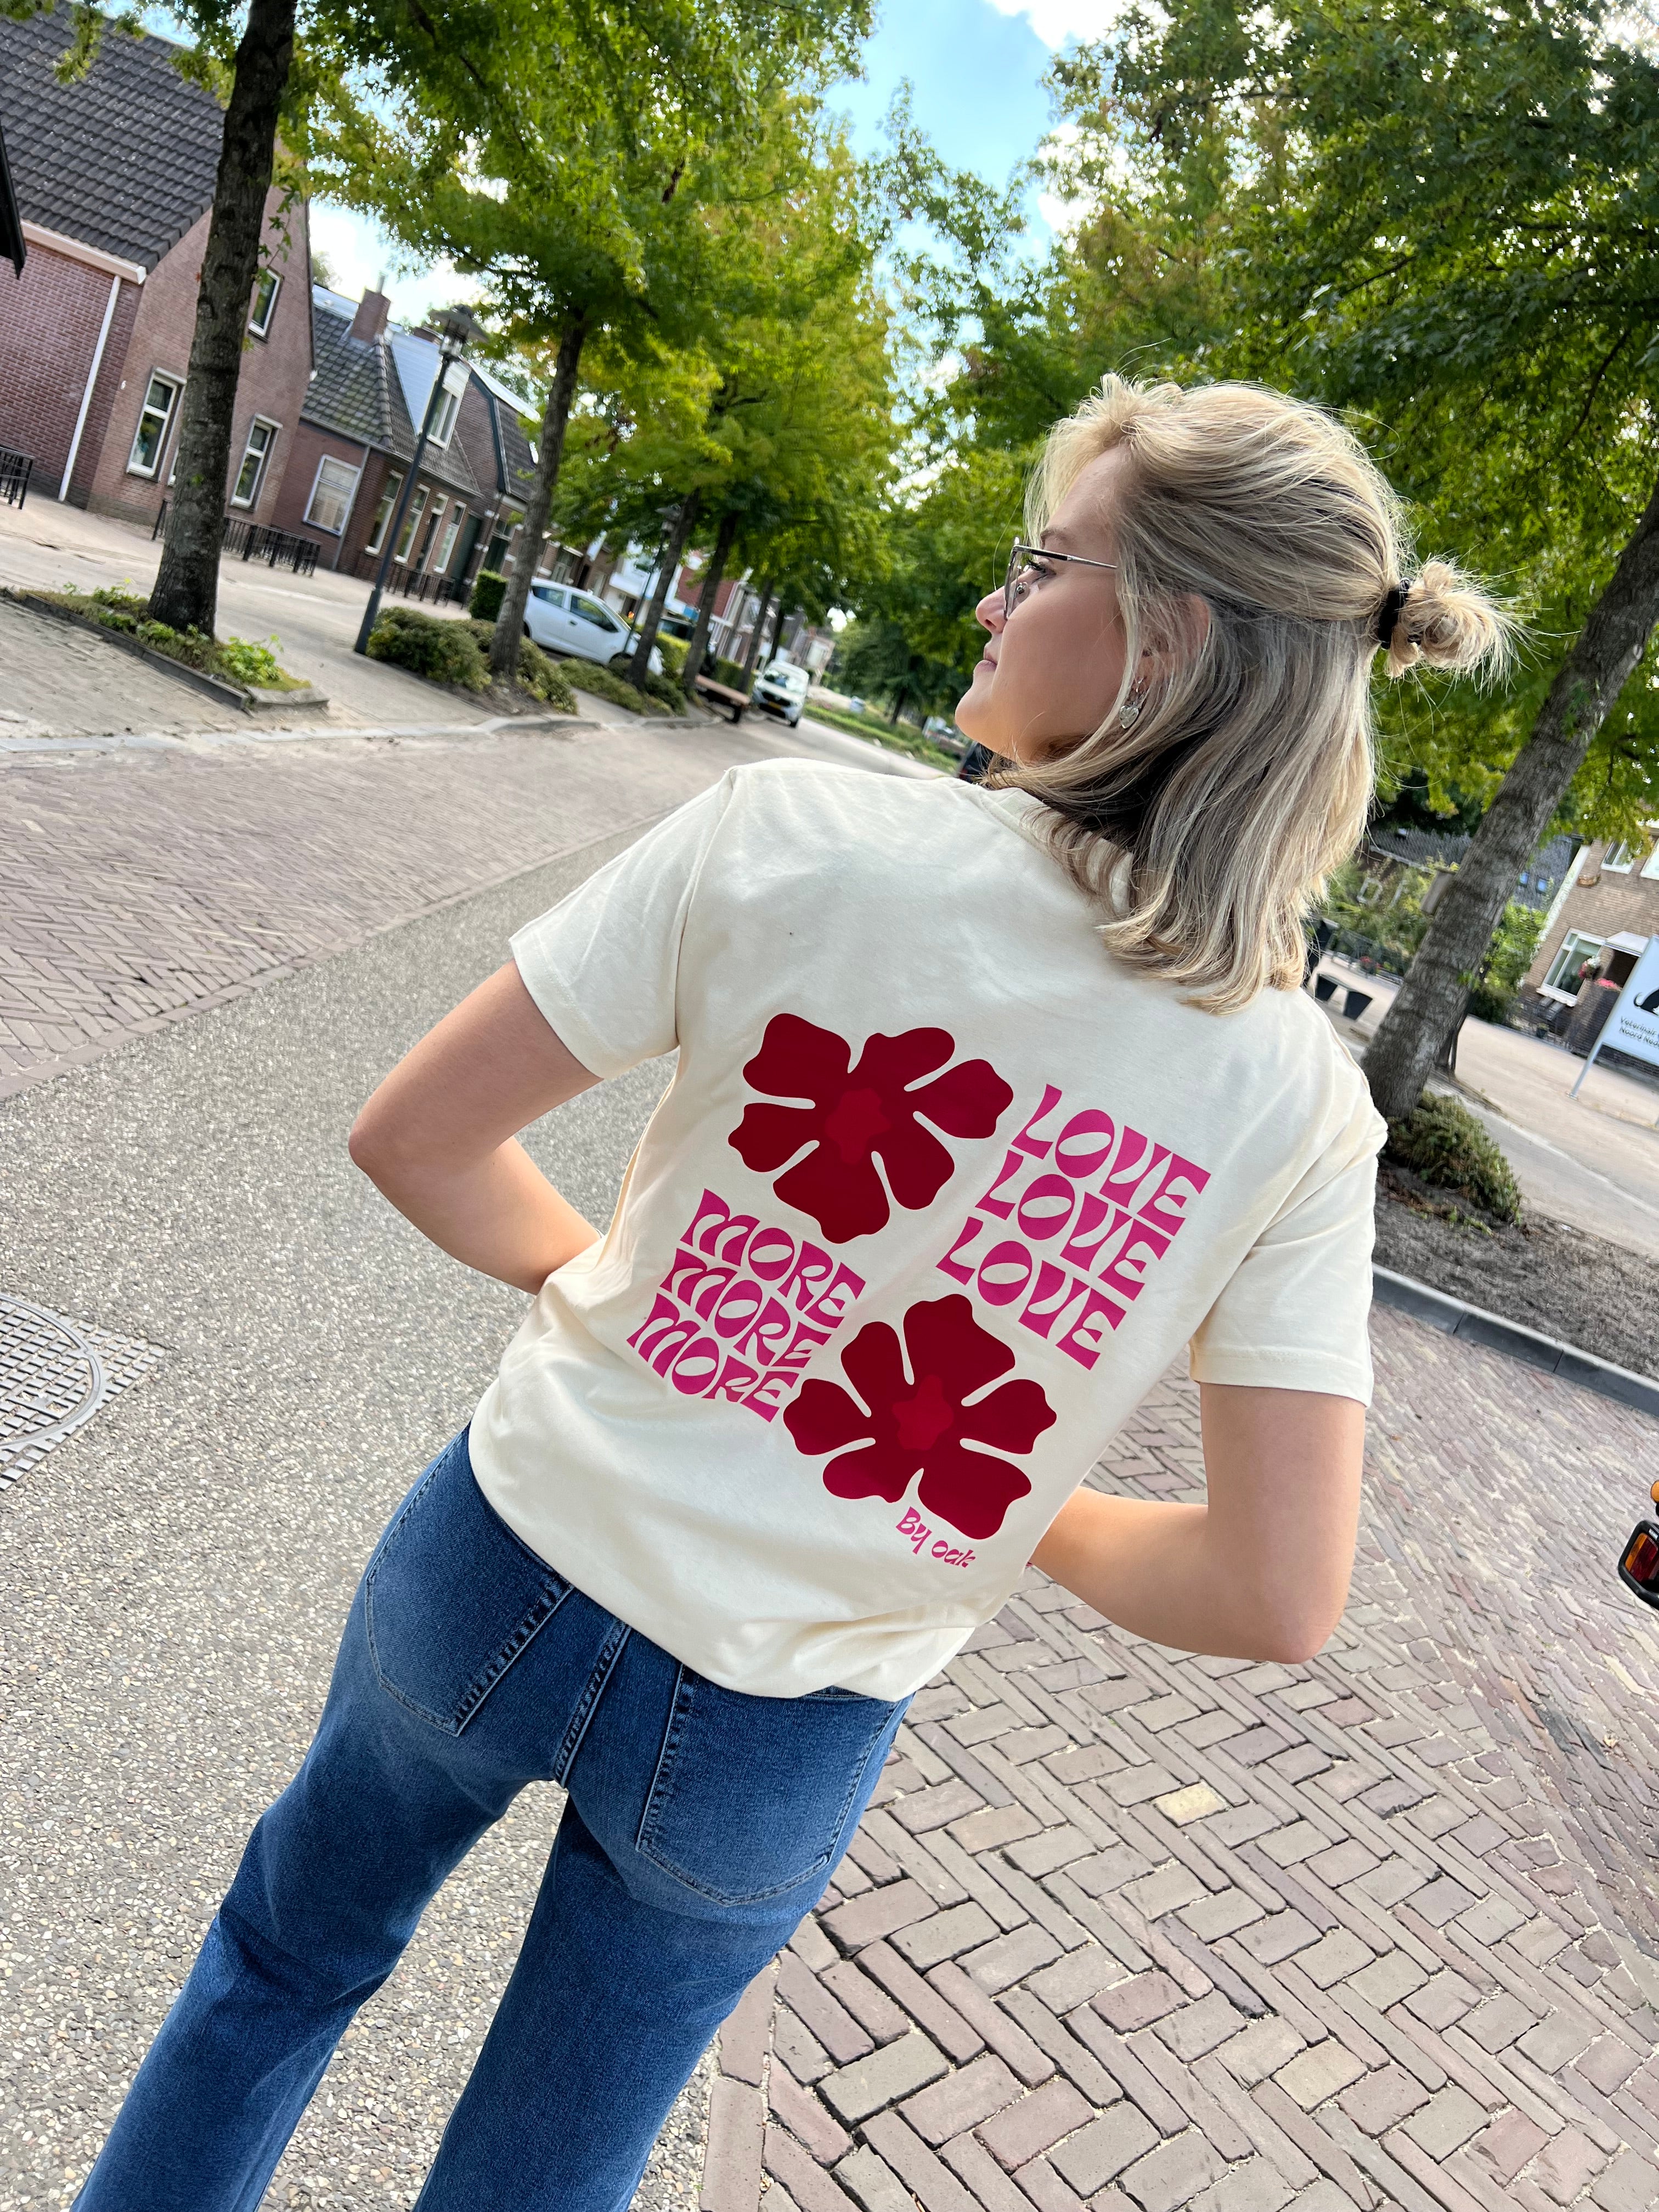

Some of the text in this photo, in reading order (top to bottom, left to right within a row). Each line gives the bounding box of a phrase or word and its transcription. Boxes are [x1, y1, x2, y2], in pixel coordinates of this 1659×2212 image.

[1619, 1026, 1644, 1040] Noord
[1620, 1015, 1656, 1036] Veterinair
[974, 1149, 1171, 1302] LOVE
[1011, 1084, 1211, 1237] LOVE
[659, 1248, 833, 1369] MORE
[680, 1188, 866, 1329] MORE
[935, 1216, 1127, 1370] LOVE
[626, 1293, 800, 1423] MORE
[895, 1506, 976, 1568] By oak
